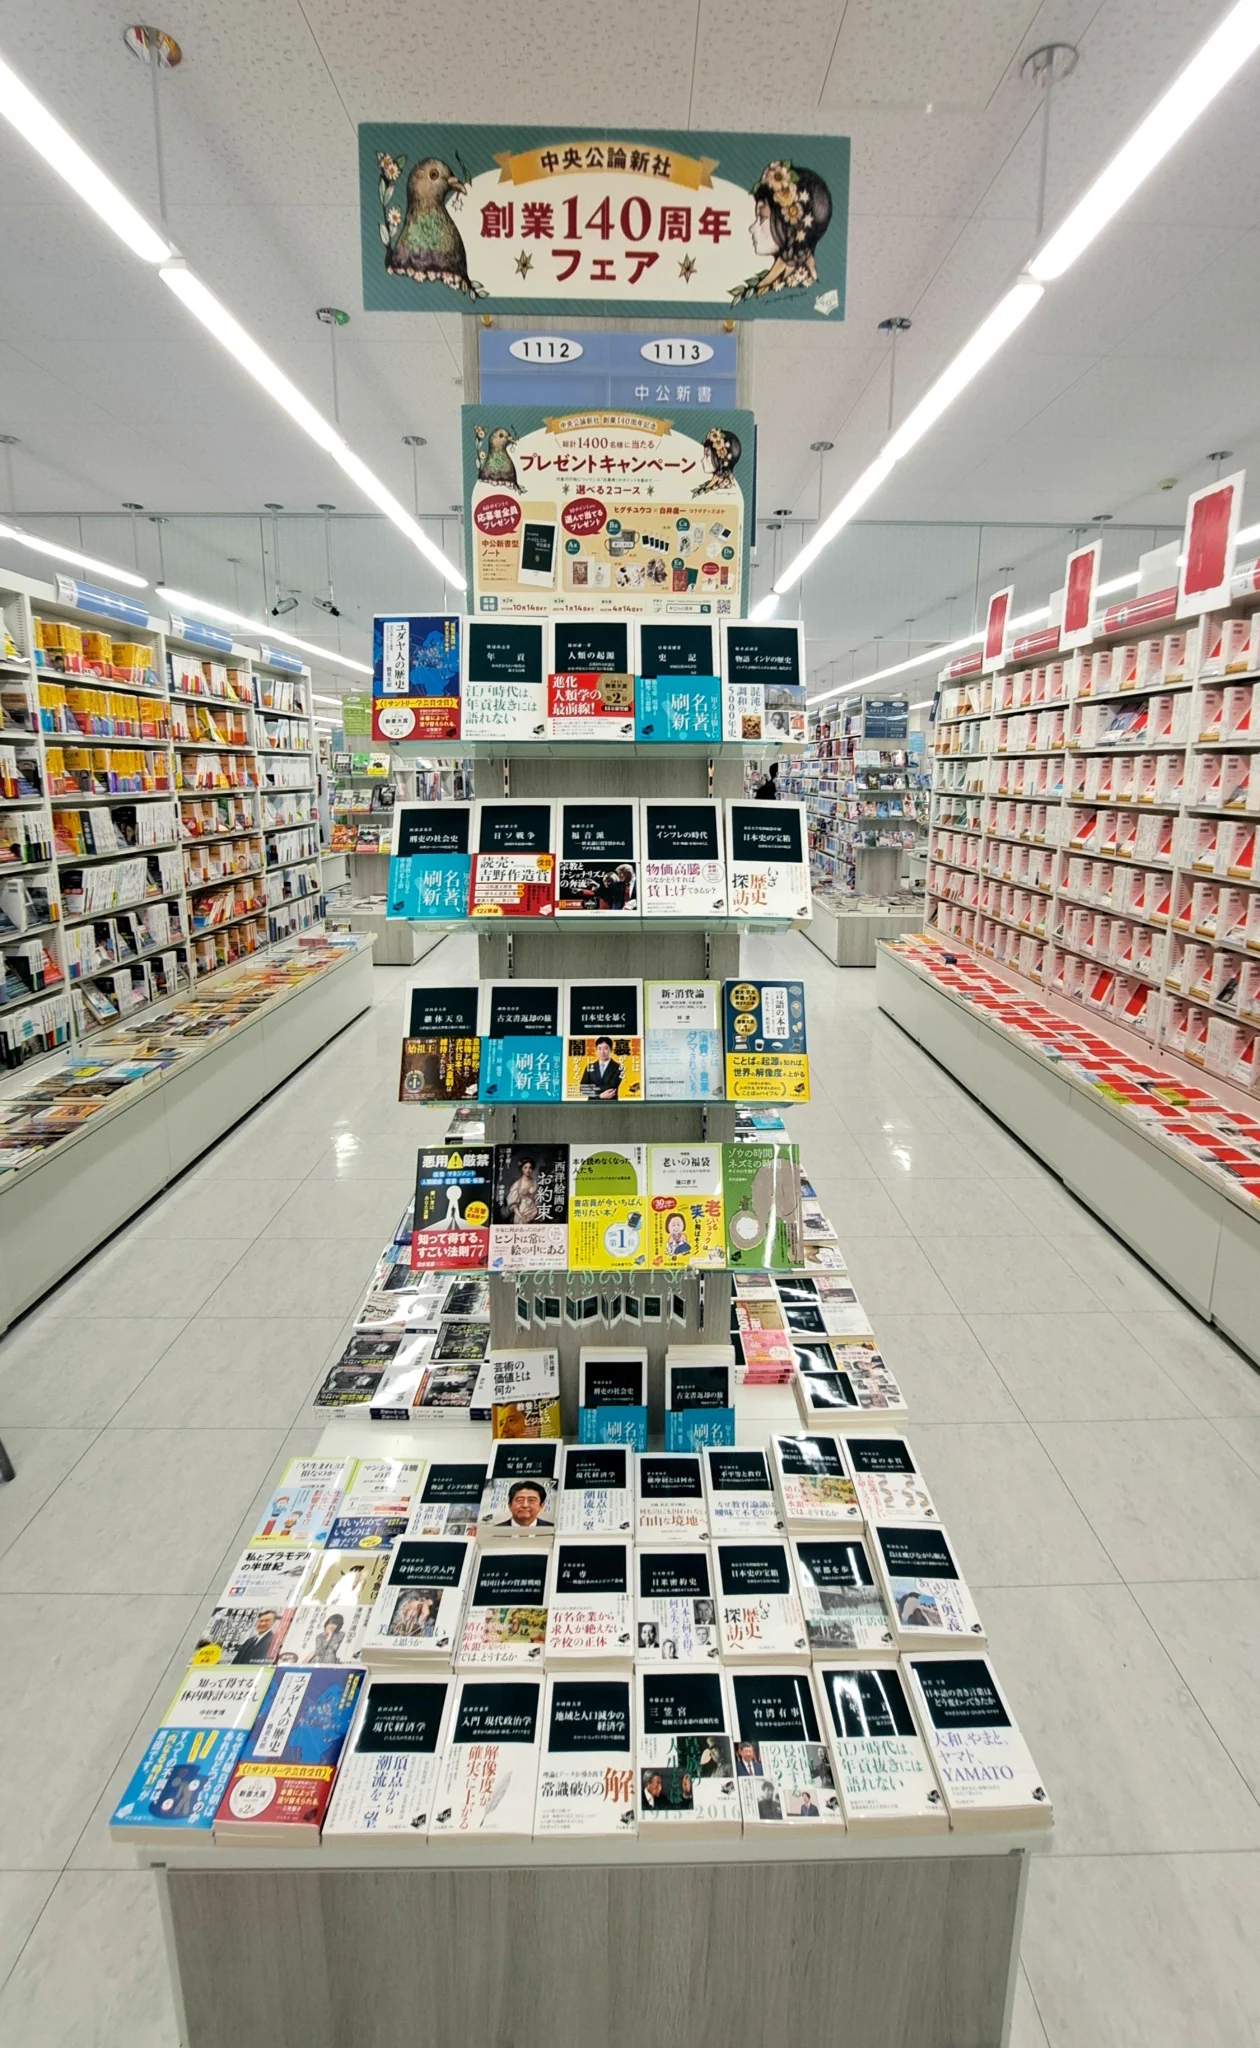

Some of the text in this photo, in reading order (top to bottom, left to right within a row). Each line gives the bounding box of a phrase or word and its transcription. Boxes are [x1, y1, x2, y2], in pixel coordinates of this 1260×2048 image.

[540, 145, 673, 179] 中央公論新社
[480, 195, 732, 243] 創業140周年
[551, 249, 660, 284] フェア
[521, 340, 570, 358] 1112
[653, 343, 700, 361] 1113
[634, 385, 712, 403] 中公新書
[560, 416, 657, 430] 中央公論新社 創業140周年記念
[562, 437, 655, 449] 総計1400名様に当たる
[519, 454, 697, 475] プレゼントキャンペーン
[576, 485, 641, 495] 選べる2コース
[481, 540, 519, 548] 中公新書型
[481, 549, 501, 557] ノート
[395, 624, 407, 690] ユダヤ人の歴史
[567, 651, 615, 660] 人類の起源
[658, 653, 697, 662] 史記
[735, 655, 792, 665] 物語 インドの歴史
[552, 676, 578, 689] 進化
[465, 685, 534, 699] 江戸時代は、
[553, 689, 602, 702] 人類学の
[465, 699, 538, 712] 年貢抜きには
[737, 686, 747, 714] 調和の
[671, 693, 690, 731] 刷新
[727, 686, 738, 738] 5000年史
[465, 712, 517, 725] 語れない
[408, 834, 459, 843] 刑吏の社会史
[494, 832, 536, 840] 日ソ戦争
[571, 832, 605, 840] 福音派
[656, 831, 708, 840] インフレの時代
[743, 834, 791, 843] 日本史の宝箱
[560, 863, 584, 871] 宗教と
[646, 863, 701, 876] 物価高騰
[480, 869, 550, 882] 吉野作造賞
[560, 871, 606, 879] ナショナリズム
[422, 870, 442, 906] 刷新
[560, 879, 588, 888] の奔流
[731, 873, 749, 915] 探訪へ
[750, 874, 768, 906] 歴史
[661, 989, 705, 999] 新・消費論
[423, 1014, 464, 1023] 継体天皇
[496, 1014, 552, 1023] 古文書返却の旅
[581, 1013, 626, 1022] 日本史を暴く
[775, 990, 786, 1036] 言語の本質
[515, 1053, 534, 1090] 刷新
[728, 1148, 773, 1159] ゾウの時間
[421, 1153, 490, 1168] 悪用 厳禁
[572, 1157, 632, 1166] 本を読めなくなった
[662, 1157, 711, 1168] 老いの福袋
[572, 1166, 594, 1174] 人たち
[552, 1160, 565, 1213] 西洋絵画の
[535, 1172, 554, 1221] お約束
[574, 1198, 643, 1208] 書店員が今いちばん
[417, 1232, 483, 1245] 知って得する、
[494, 1233, 546, 1244] ヒントは常に
[417, 1244, 485, 1259] すごい法則77
[510, 1244, 566, 1256] 絵の中にある
[493, 1360, 525, 1374] 芸術の
[493, 1372, 531, 1385] 価値とは
[493, 1385, 516, 1397] 何か
[593, 1387, 634, 1395] 刑吏の社会史
[676, 1391, 724, 1400] 古文書返却の旅
[506, 1461, 543, 1470] 安倍晋三
[861, 1456, 904, 1465] 生命の本質
[575, 1471, 616, 1479] 現代経済学
[721, 1470, 762, 1478] 不平等と教育
[328, 1537, 359, 1548] 誰だ?
[240, 1561, 285, 1572] の半世紀
[398, 1565, 456, 1574] 身体の美学入門
[561, 1569, 587, 1578] 高専
[731, 1569, 779, 1578] 日本史の宝箱
[479, 1579, 542, 1588] 戦国日本の資源戦略
[652, 1578, 698, 1587] 日米密約史
[553, 1611, 615, 1622] 有名企業から
[551, 1624, 624, 1635] 求人が絶えない
[723, 1607, 745, 1650] 探訪へ
[742, 1607, 764, 1640] 歴史
[549, 1636, 608, 1649] 学校の正体
[180, 1690, 261, 1702] 体内時計のはなし
[924, 1687, 993, 1698] 日本語の書き言葉は
[934, 1697, 996, 1708] どう変わってきたか
[269, 1674, 307, 1754] ユダヤ人の歴史
[554, 1710, 625, 1721] 地域と人口減少の
[649, 1706, 687, 1717] 三笠宮
[753, 1706, 801, 1718] 台湾有事
[461, 1715, 532, 1726] 入門 現代政治学
[597, 1721, 626, 1731] 経済学
[372, 1722, 427, 1733] 現代経済学
[934, 1730, 1009, 1748] 大和、やまと、
[836, 1741, 914, 1757] 江戸時代は、
[938, 1749, 985, 1765] ヤマト、
[782, 1742, 802, 1798] 侵攻する
[841, 1758, 924, 1775] 年貢抜きには
[479, 1745, 500, 1807] 解像度が
[943, 1766, 1014, 1782] YAMATO
[458, 1745, 483, 1830] 確実に上がる
[541, 1768, 634, 1803] 常識破りの解
[846, 1776, 904, 1793] 語れない
[363, 1755, 391, 1829] 潮流を一望
